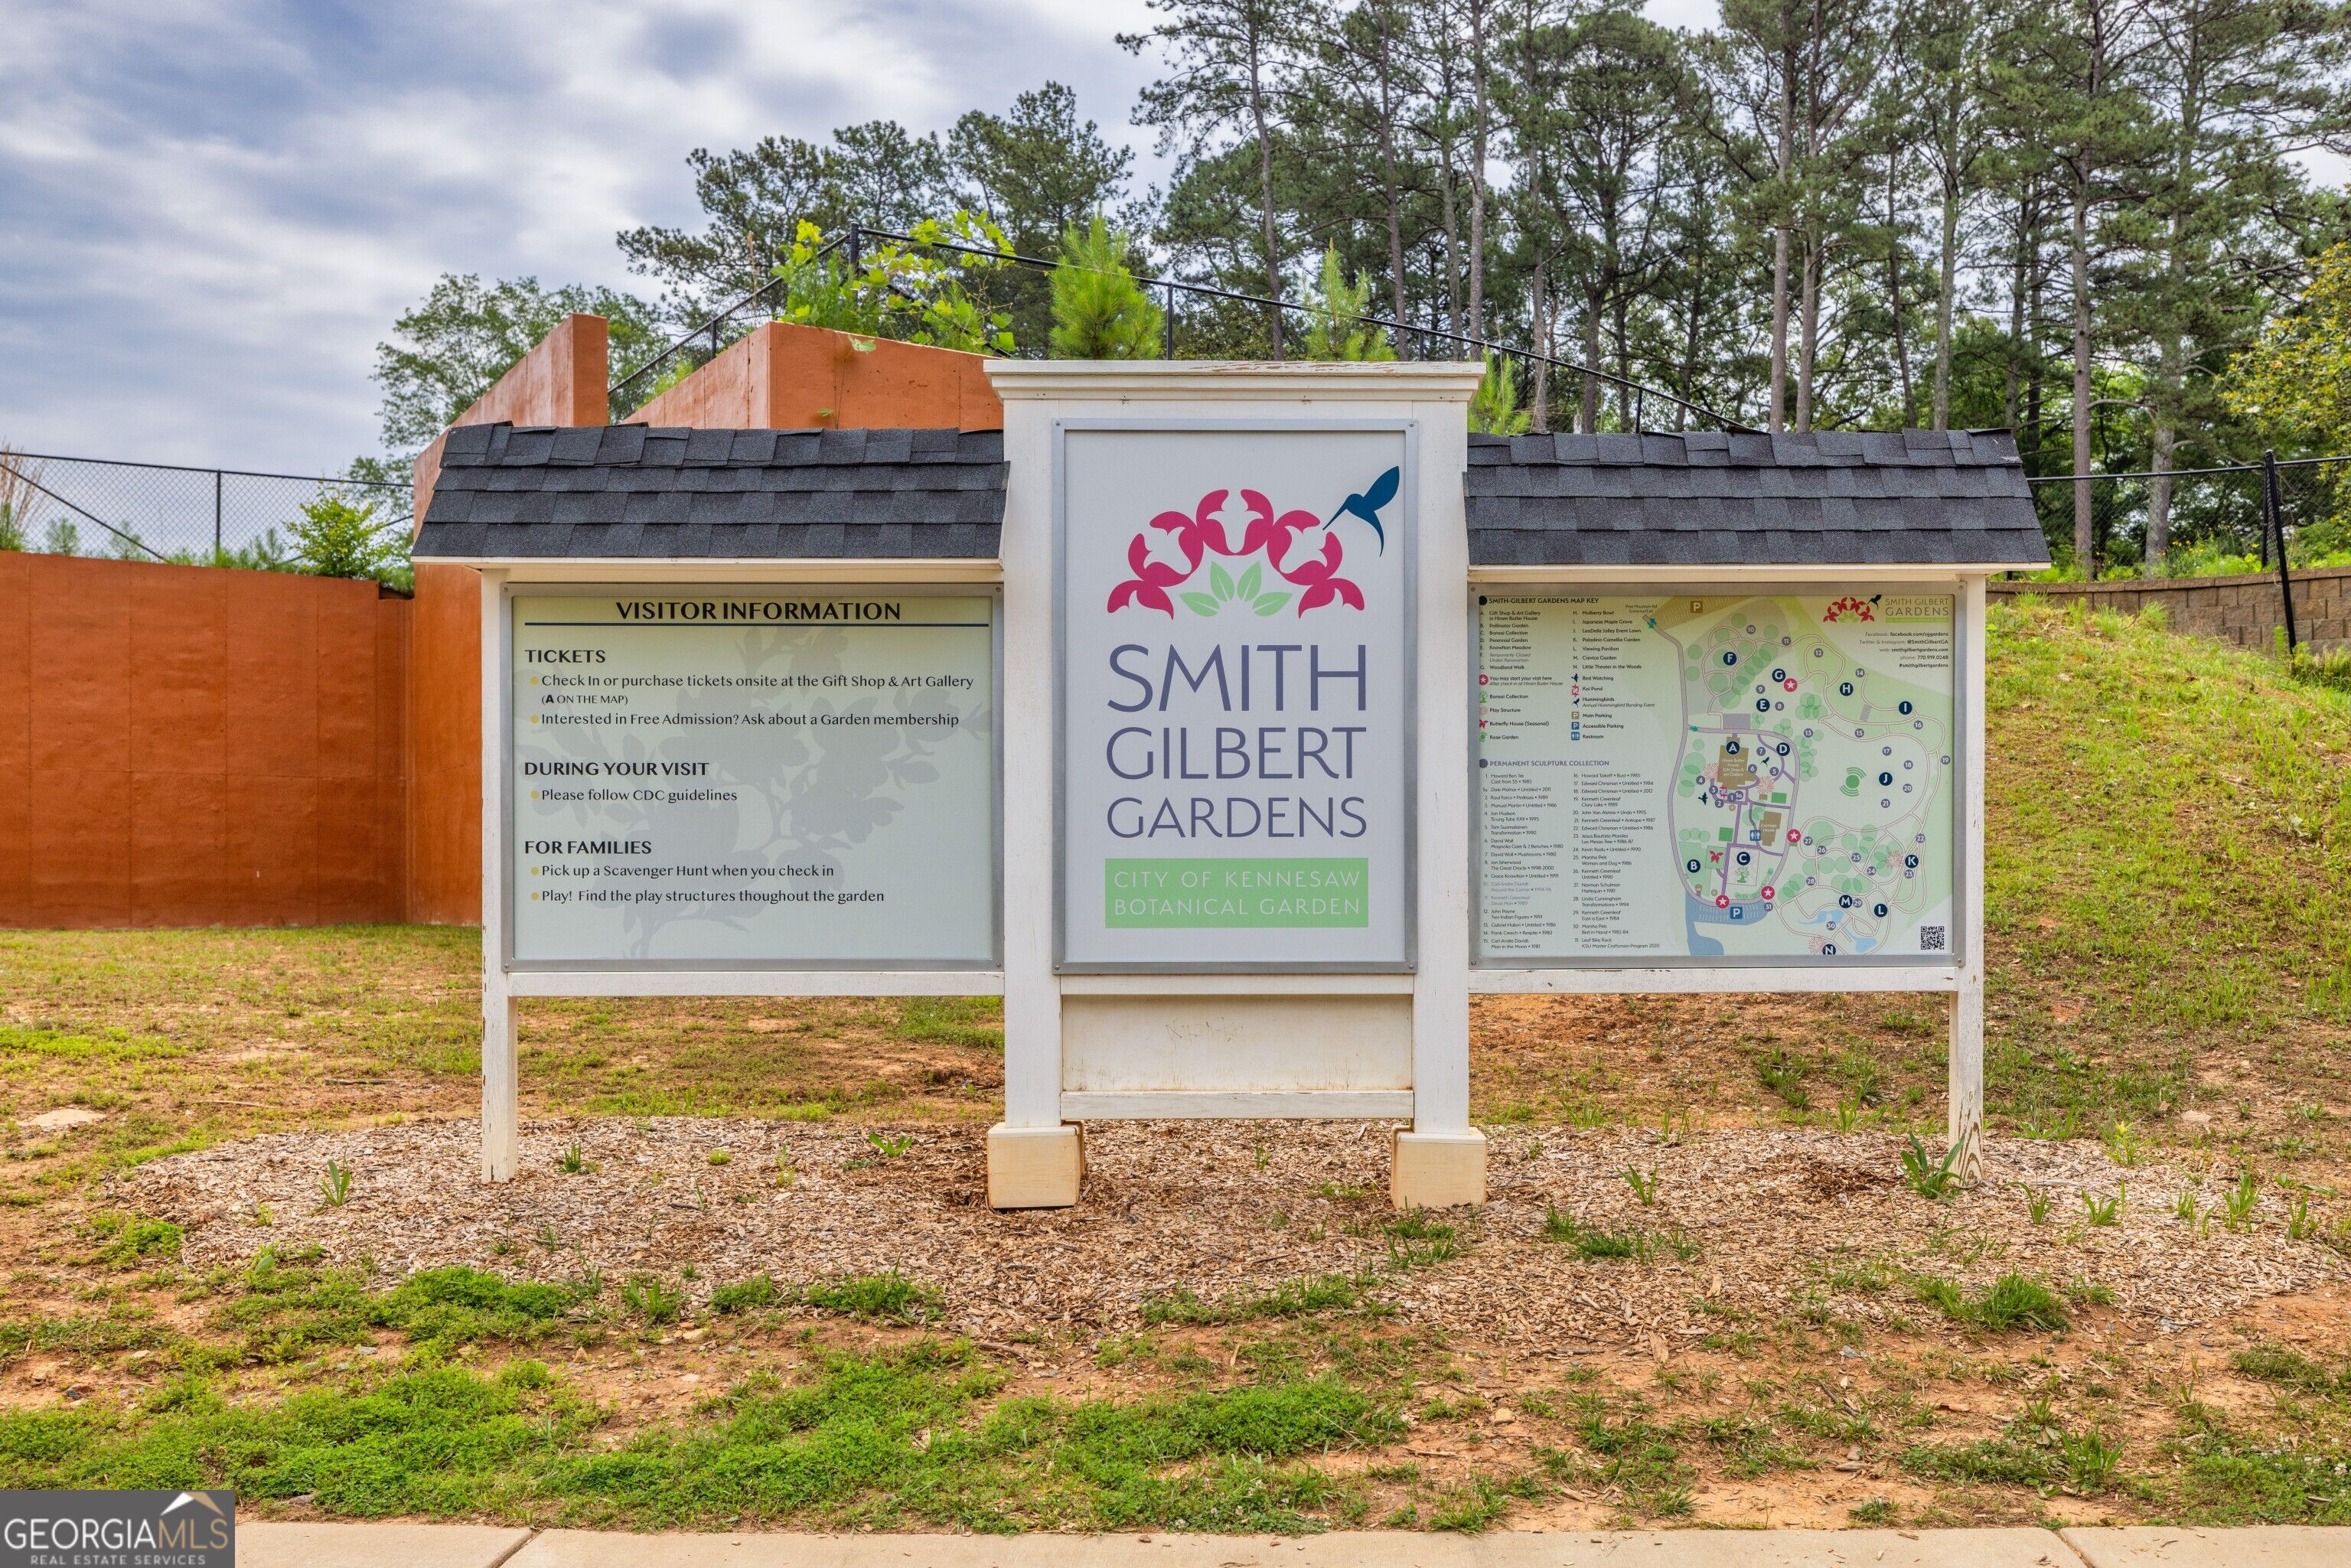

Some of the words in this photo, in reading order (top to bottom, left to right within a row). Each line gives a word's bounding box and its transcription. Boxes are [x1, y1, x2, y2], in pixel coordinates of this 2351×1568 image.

[1885, 598, 1912, 606] SMITH
[1914, 598, 1949, 606] GILBERT
[616, 602, 717, 619] VISITOR
[723, 602, 900, 620] INFORMATION
[1885, 606, 1949, 616] GARDENS
[525, 650, 605, 663] TICKETS
[542, 674, 585, 686] Check
[589, 676, 599, 686] In
[603, 677, 619, 686] or
[622, 675, 683, 689] purchase
[687, 675, 732, 686] tickets
[736, 675, 777, 686] onsite
[781, 676, 794, 686] at
[797, 675, 818, 686] the
[823, 675, 847, 686] Gift
[852, 676, 885, 689] Shop
[889, 675, 898, 686] &
[902, 675, 922, 686] Art
[926, 675, 974, 689] Gallery
[1107, 644, 1365, 712] SMITH
[541, 694, 555, 705] (A
[556, 695, 574, 704] ON
[576, 695, 598, 704] THE
[601, 696, 628, 706] MAP)
[543, 713, 611, 724] Interested
[616, 713, 626, 724] in
[631, 714, 660, 725] Free
[663, 713, 739, 725] Admission?
[742, 713, 765, 725] Ask
[768, 713, 807, 725] about
[810, 716, 817, 725] a
[821, 714, 869, 725] Garden
[874, 714, 958, 728] membership
[1107, 727, 1366, 780] GILBERT
[525, 762, 598, 775] DURING
[603, 763, 657, 775] YOUR
[661, 763, 709, 775] VISIT
[543, 789, 584, 800] Please
[588, 789, 629, 800] follow
[633, 791, 664, 800] CDC
[668, 790, 737, 804] guidelines
[1107, 797, 1366, 838] GARDENS
[525, 841, 562, 854] FOR
[568, 841, 651, 854] FAMILIES
[543, 865, 569, 875] Pick
[574, 868, 589, 879] up
[592, 867, 600, 876] a
[604, 865, 673, 879] Scavenger
[677, 865, 709, 876] Hunt
[712, 865, 747, 875] when
[751, 869, 774, 879] you
[779, 865, 819, 875] check
[823, 865, 833, 875] in
[1115, 872, 1168, 888] CITY
[1182, 872, 1211, 888] OF
[1226, 871, 1359, 888] KENNESAW
[543, 890, 572, 904] Play!
[579, 890, 605, 901] Find
[611, 890, 631, 901] the
[636, 890, 662, 904] play
[665, 891, 735, 901] structures
[739, 890, 809, 904] thoughout
[814, 890, 834, 901] the
[838, 890, 883, 904] garden
[1115, 898, 1248, 915] BOTANICAL
[1260, 898, 1358, 914] GARDEN
